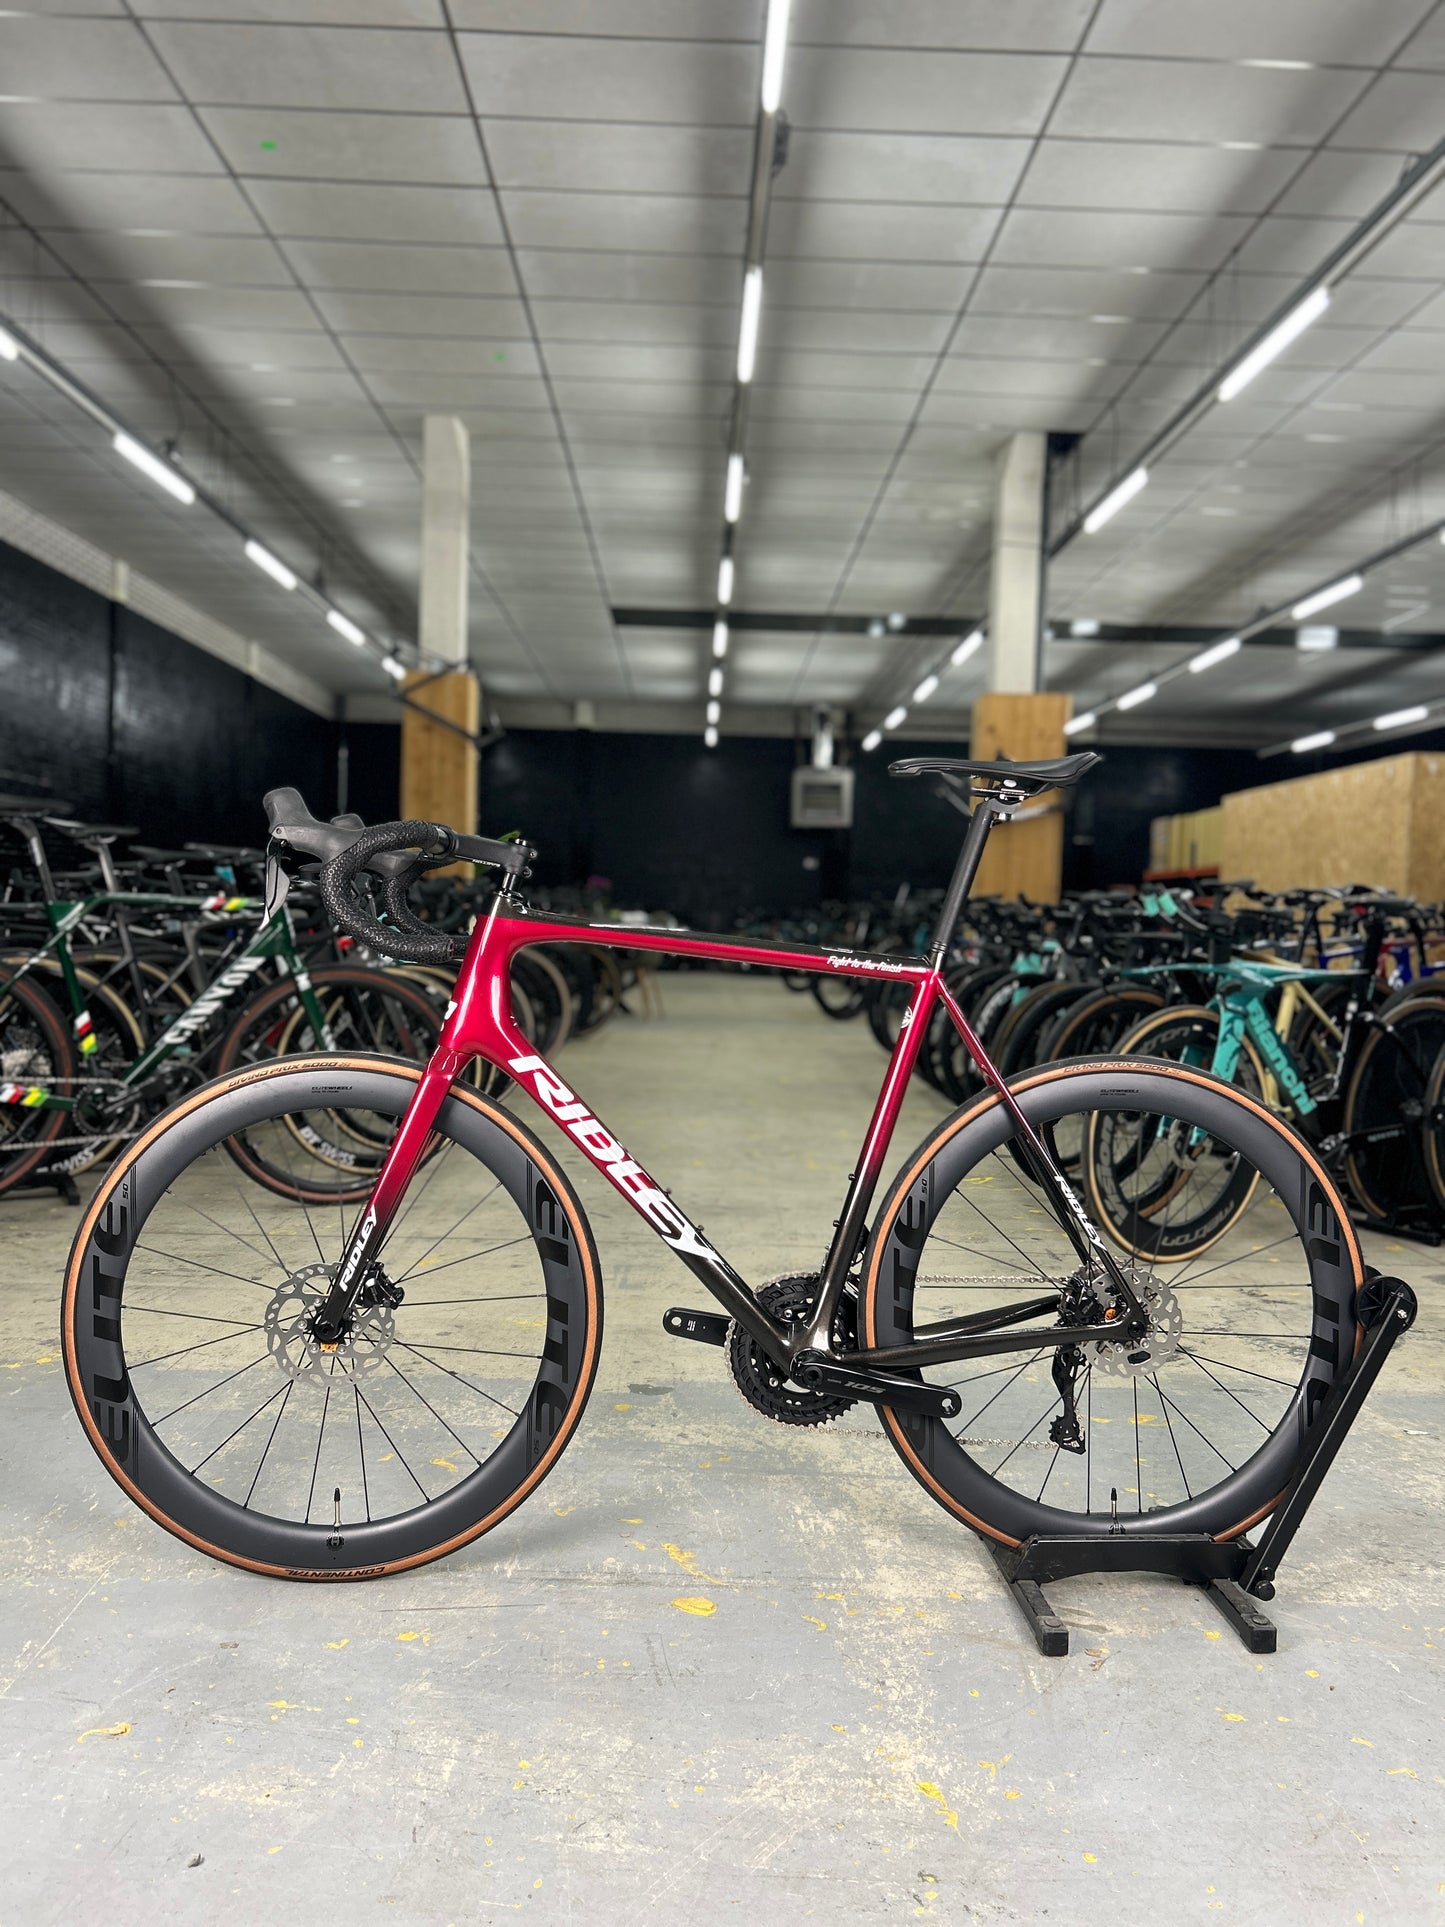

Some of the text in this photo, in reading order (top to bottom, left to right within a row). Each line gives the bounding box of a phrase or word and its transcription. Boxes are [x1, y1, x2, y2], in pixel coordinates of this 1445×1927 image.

[827, 955, 851, 968] Fight
[862, 960, 875, 970] the
[163, 956, 266, 1044] CANYON
[302, 1061, 338, 1069] 5000
[1246, 998, 1317, 1115] Bianchi
[299, 1126, 356, 1166] DT SWISS
[508, 1055, 725, 1265] RIDLEY
[122, 1183, 129, 1200] 50
[339, 1204, 377, 1292] RIDLEY
